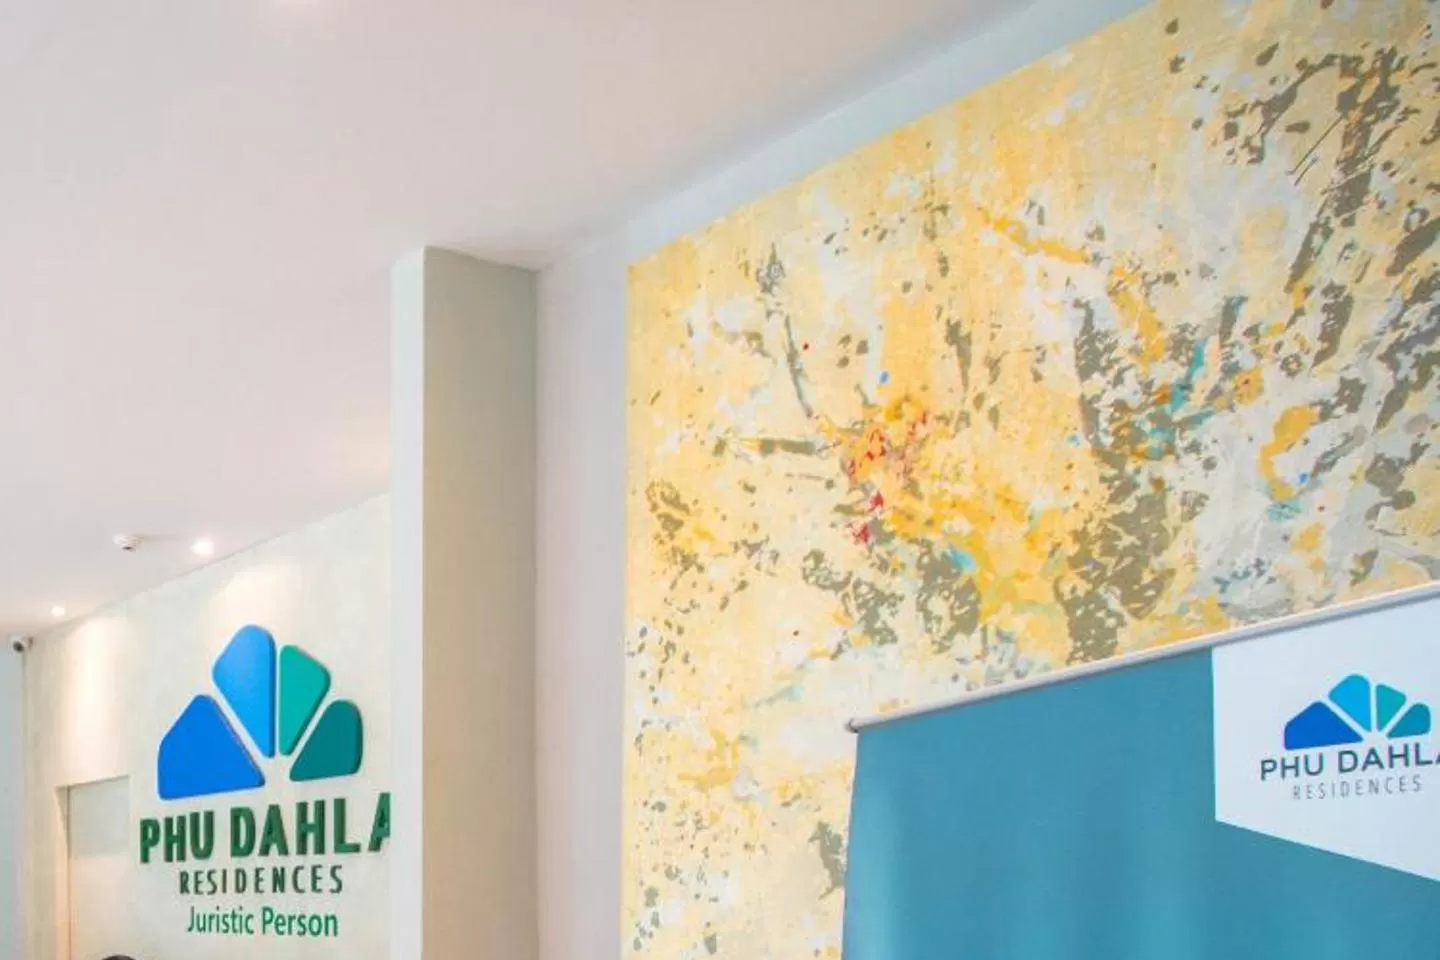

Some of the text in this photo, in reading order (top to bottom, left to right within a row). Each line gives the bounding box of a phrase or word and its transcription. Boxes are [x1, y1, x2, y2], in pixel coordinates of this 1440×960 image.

[1260, 742, 1440, 781] PHU DAHL
[1293, 774, 1423, 800] RESIDENCES
[140, 810, 215, 863] PHU
[179, 864, 344, 895] RESIDENCES
[187, 905, 339, 937] Juristic Person
